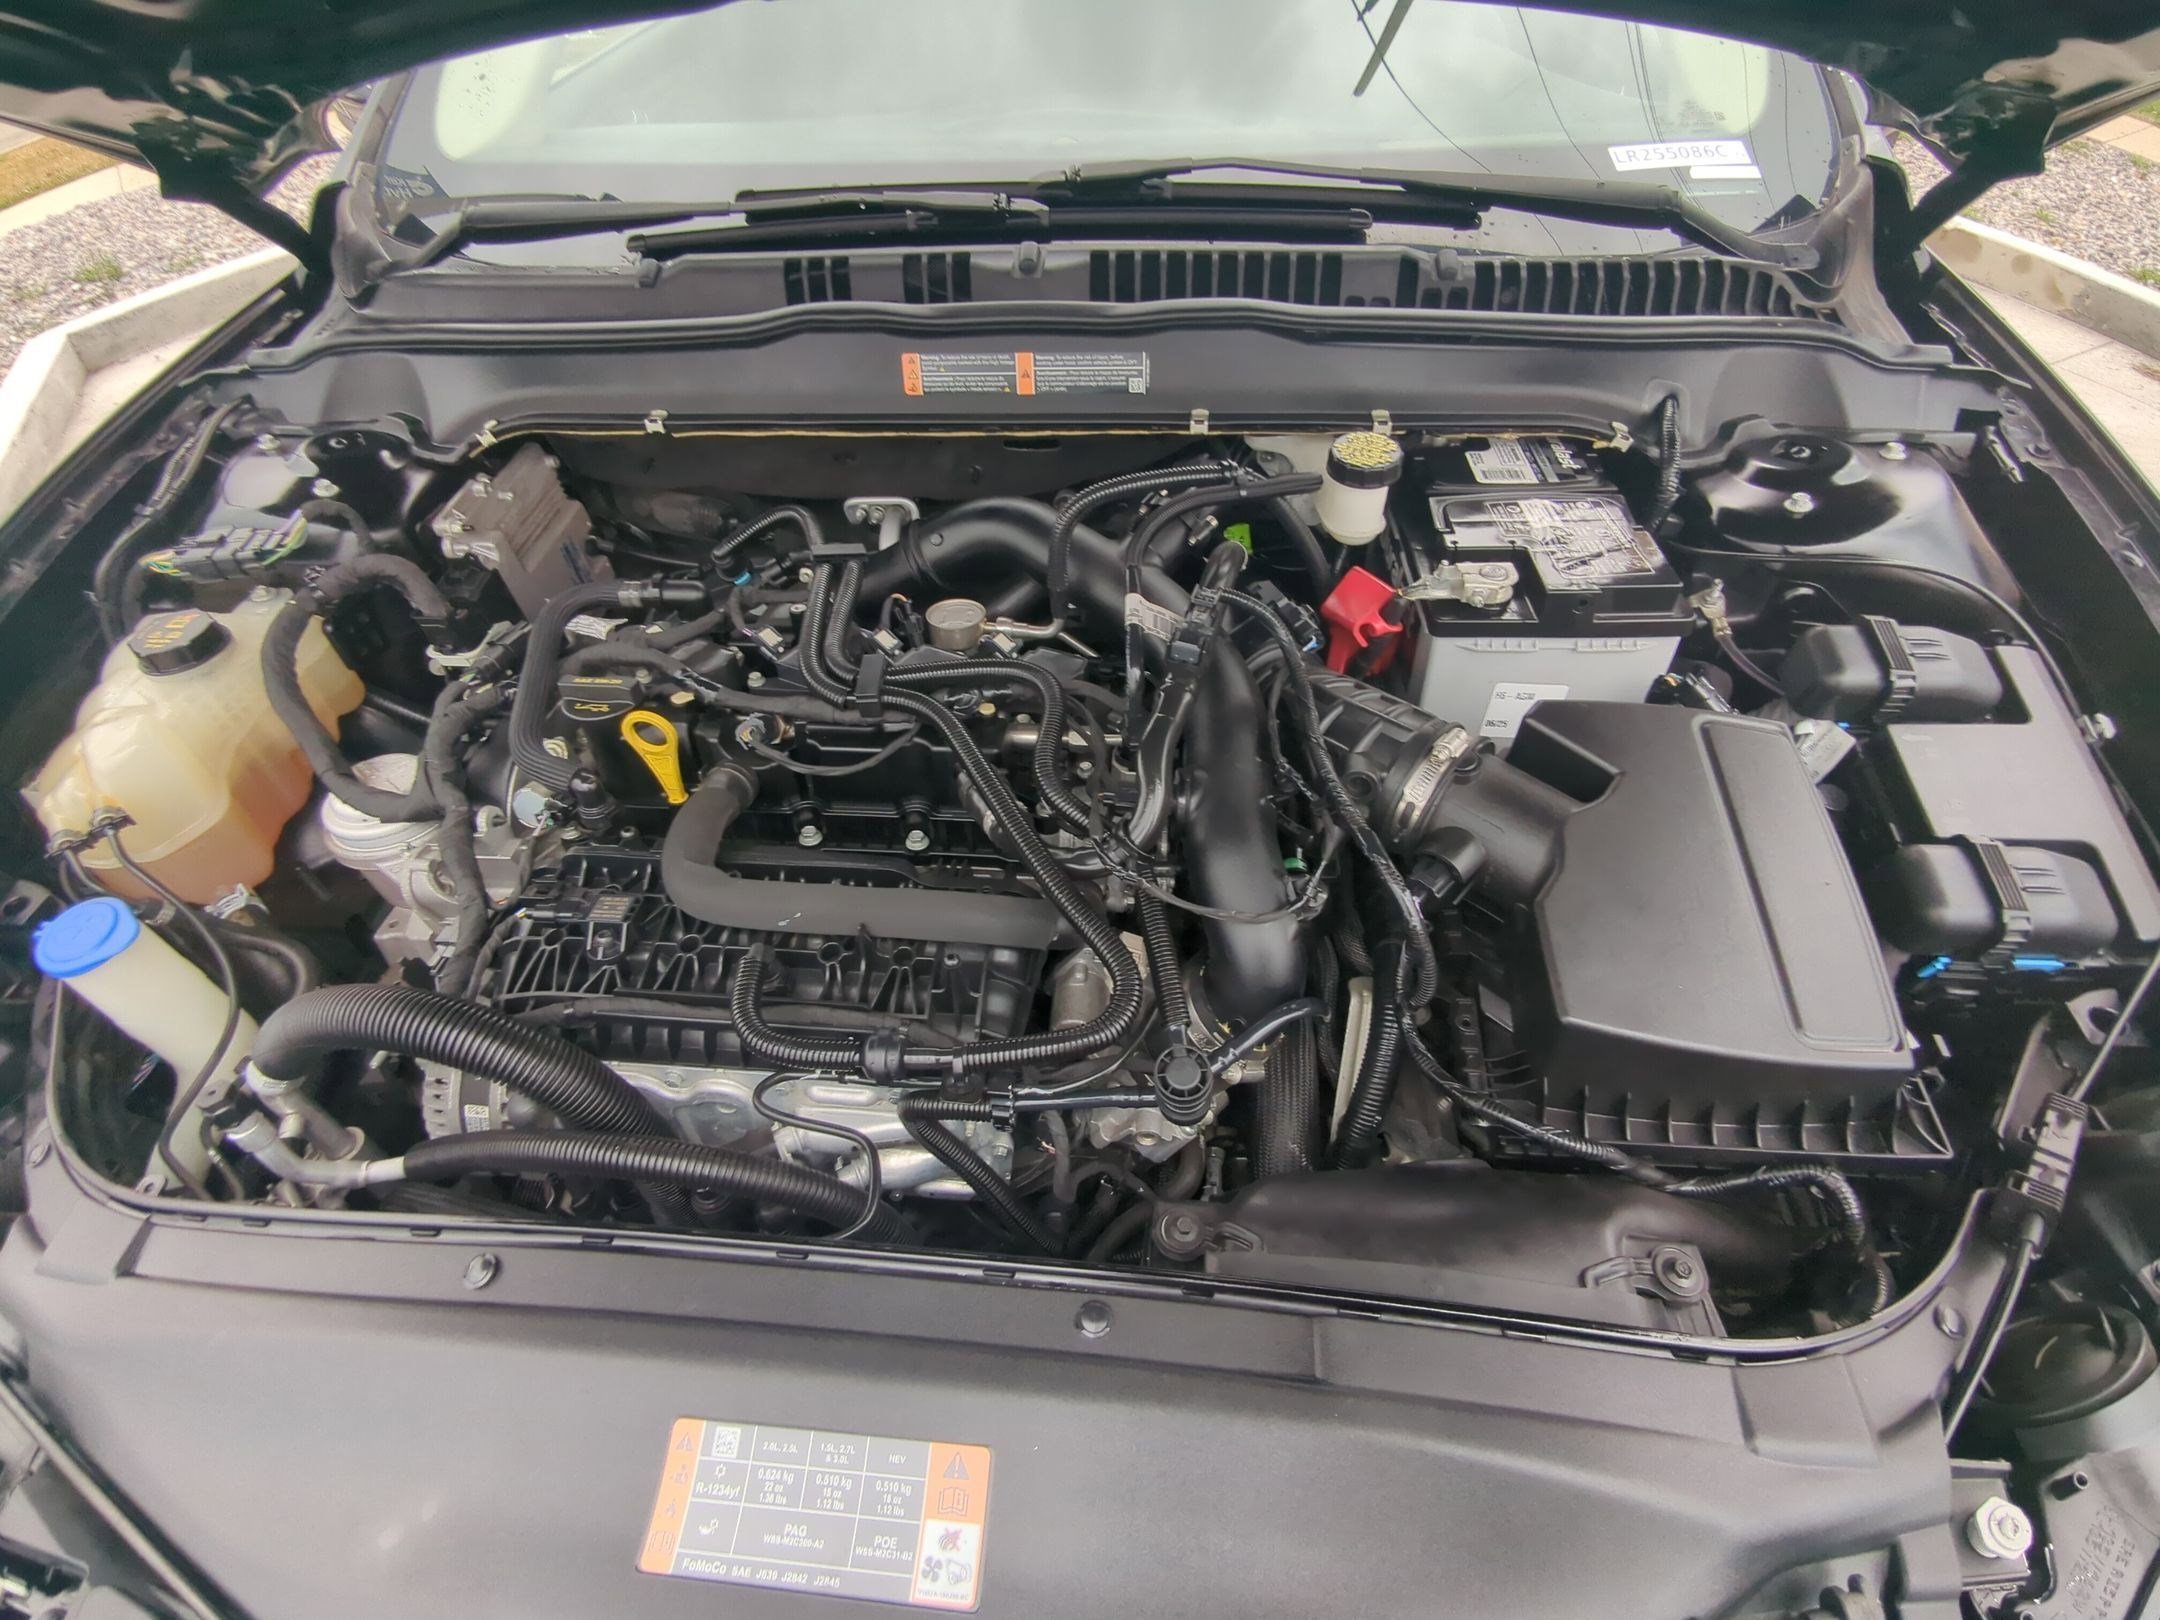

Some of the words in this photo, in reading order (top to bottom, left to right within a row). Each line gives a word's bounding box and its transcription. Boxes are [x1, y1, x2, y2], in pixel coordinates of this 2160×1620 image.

[1613, 144, 1729, 164] LR255086C
[889, 1454, 906, 1465] HEV
[758, 1467, 781, 1480] 0.624
[782, 1470, 794, 1485] kg
[815, 1473, 840, 1486] 0.510
[841, 1476, 852, 1490] kg
[695, 1481, 741, 1500] R-1234yf
[764, 1481, 774, 1491] 22
[774, 1483, 784, 1492] oz
[832, 1489, 842, 1498] oz
[875, 1479, 899, 1492] 0.510
[900, 1482, 912, 1496] kg
[775, 1495, 787, 1505] lbs
[816, 1498, 832, 1510] 1.12
[833, 1500, 845, 1511] lbs
[893, 1495, 902, 1505] oz
[876, 1504, 892, 1515] 1.12
[893, 1506, 905, 1517] lbs
[784, 1523, 808, 1537] PAG
[873, 1535, 898, 1549] POE
[682, 1557, 727, 1575] FoMoCo
